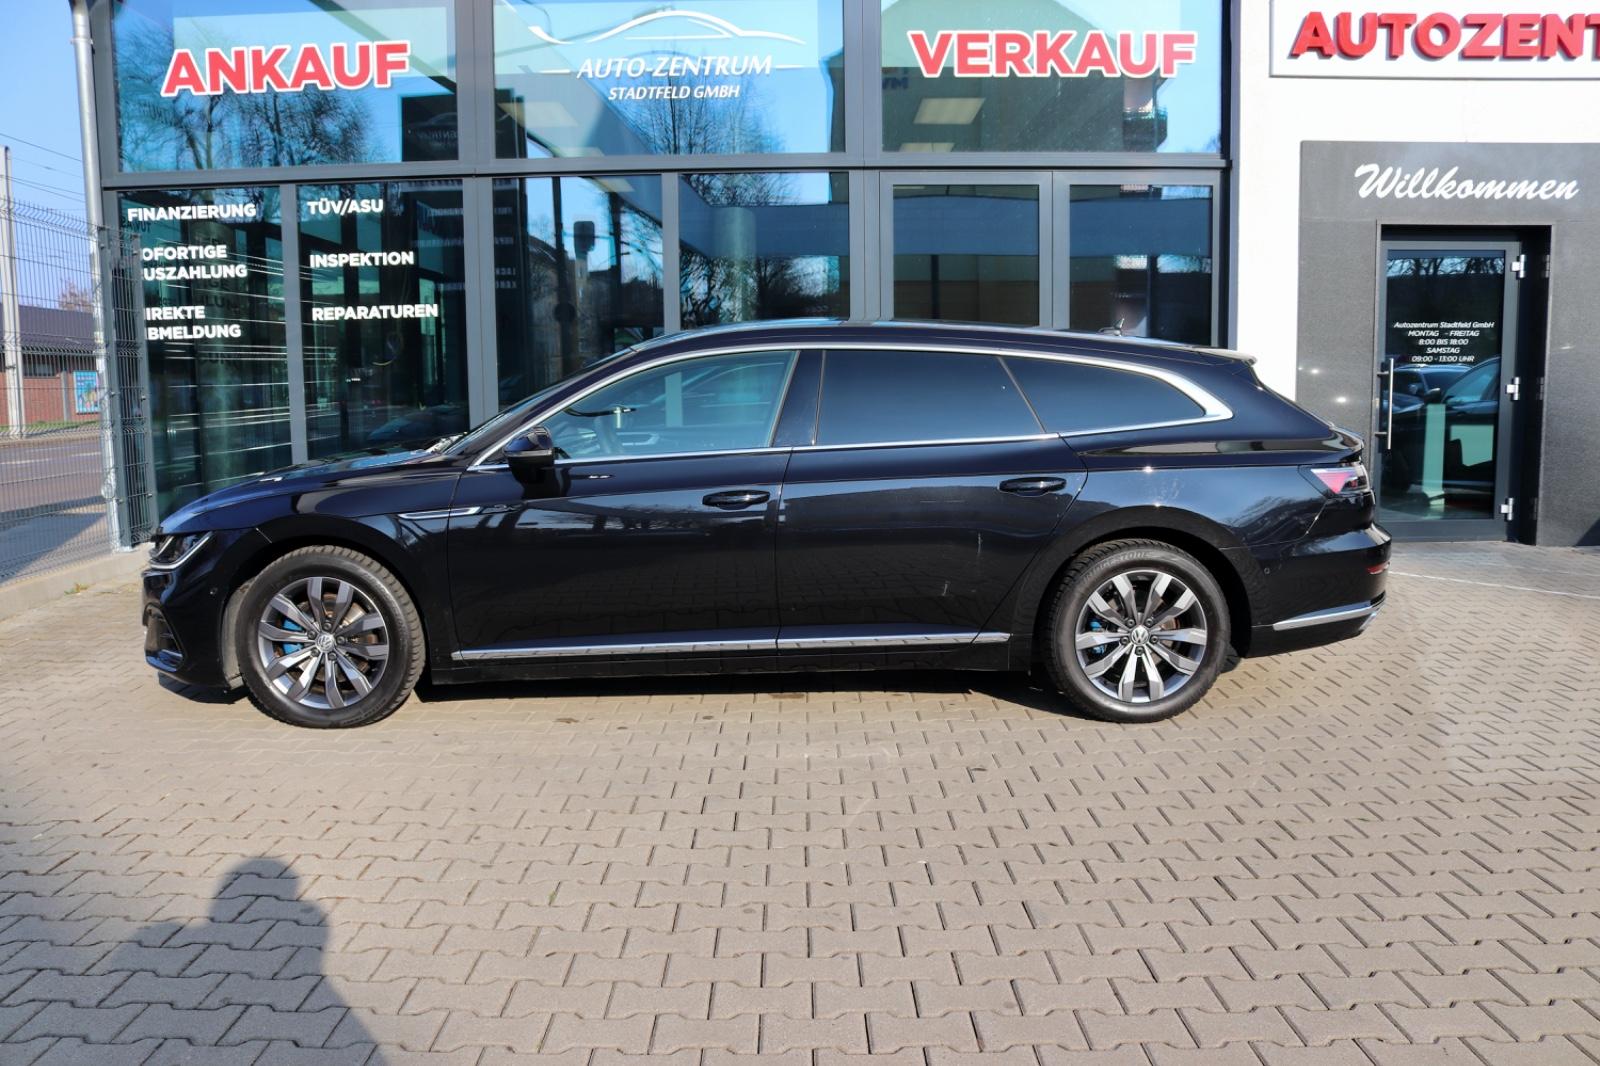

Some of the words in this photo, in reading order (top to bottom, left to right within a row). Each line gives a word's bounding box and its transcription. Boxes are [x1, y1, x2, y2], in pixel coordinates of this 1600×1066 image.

[907, 30, 1197, 79] VERKAUF
[161, 40, 410, 97] ANKAUF
[576, 55, 772, 79] AUTO-ZENTRUM
[608, 86, 690, 100] STADTFELD
[694, 85, 740, 98] GMBH
[1354, 163, 1578, 200] Willkommen
[127, 203, 256, 222] FINANZIERUNG
[307, 198, 384, 216] TÜV/ASU
[142, 245, 227, 261] OFORTIGE
[309, 251, 414, 268] INSPEKTION
[143, 264, 247, 281] USZAHLUNG
[144, 306, 205, 321] IREKTE
[312, 303, 438, 321] REPARATUREN
[146, 324, 241, 341] BMELDUNG
